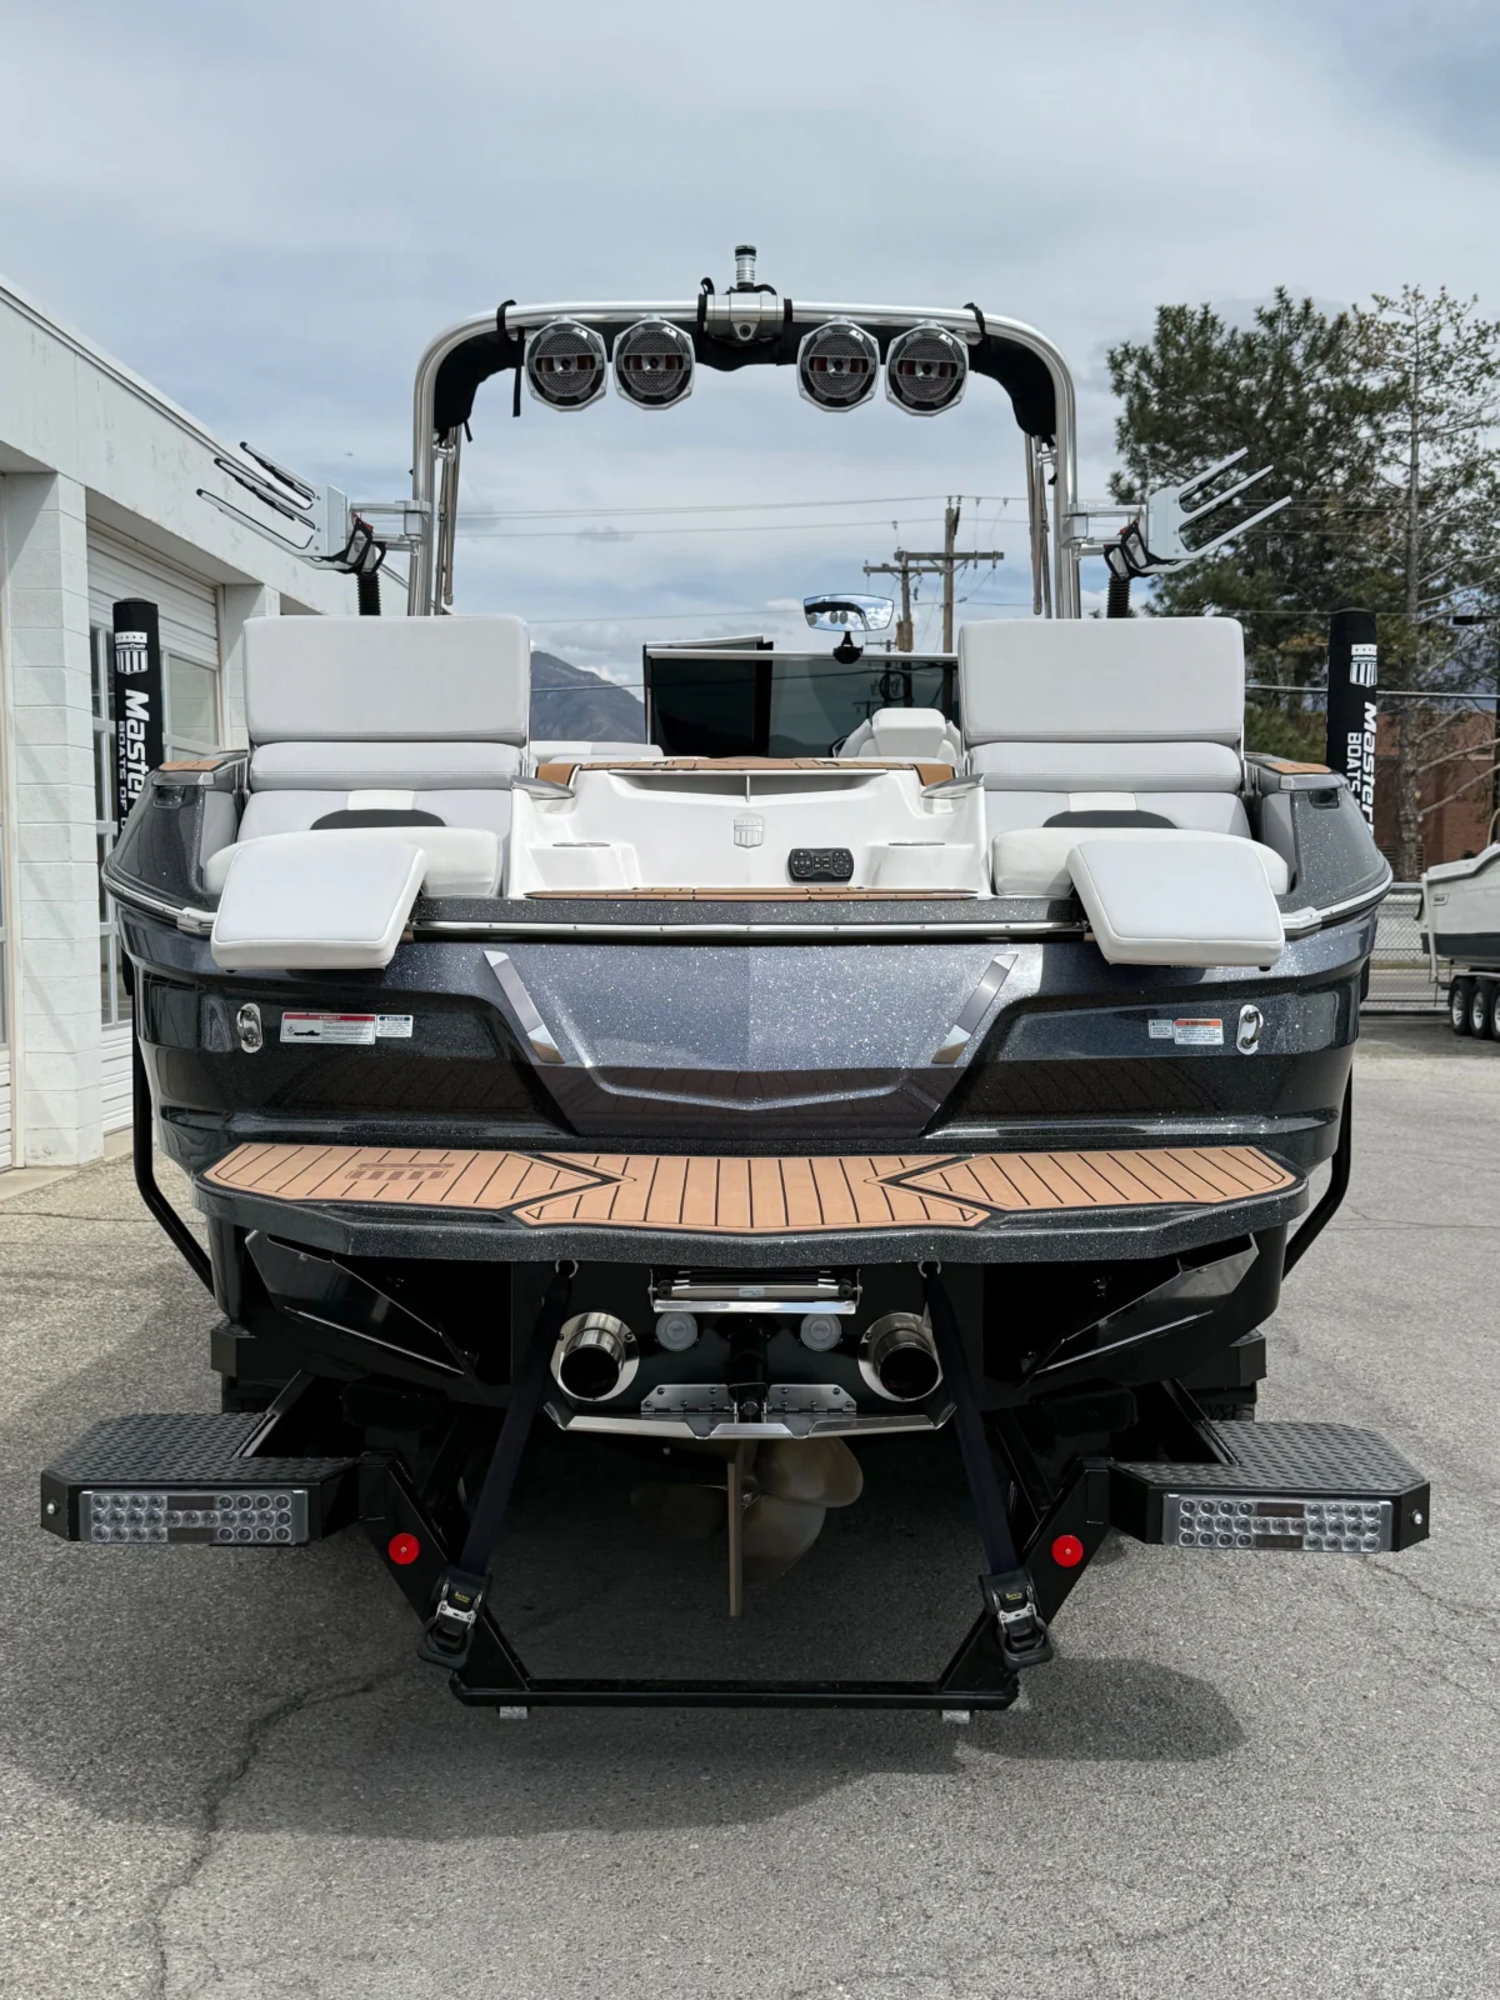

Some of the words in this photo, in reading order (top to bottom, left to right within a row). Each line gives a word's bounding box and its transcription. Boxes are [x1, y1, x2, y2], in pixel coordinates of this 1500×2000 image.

[118, 720, 127, 780] BOATS
[1346, 732, 1362, 793] BOATS
[119, 786, 128, 811] OF
